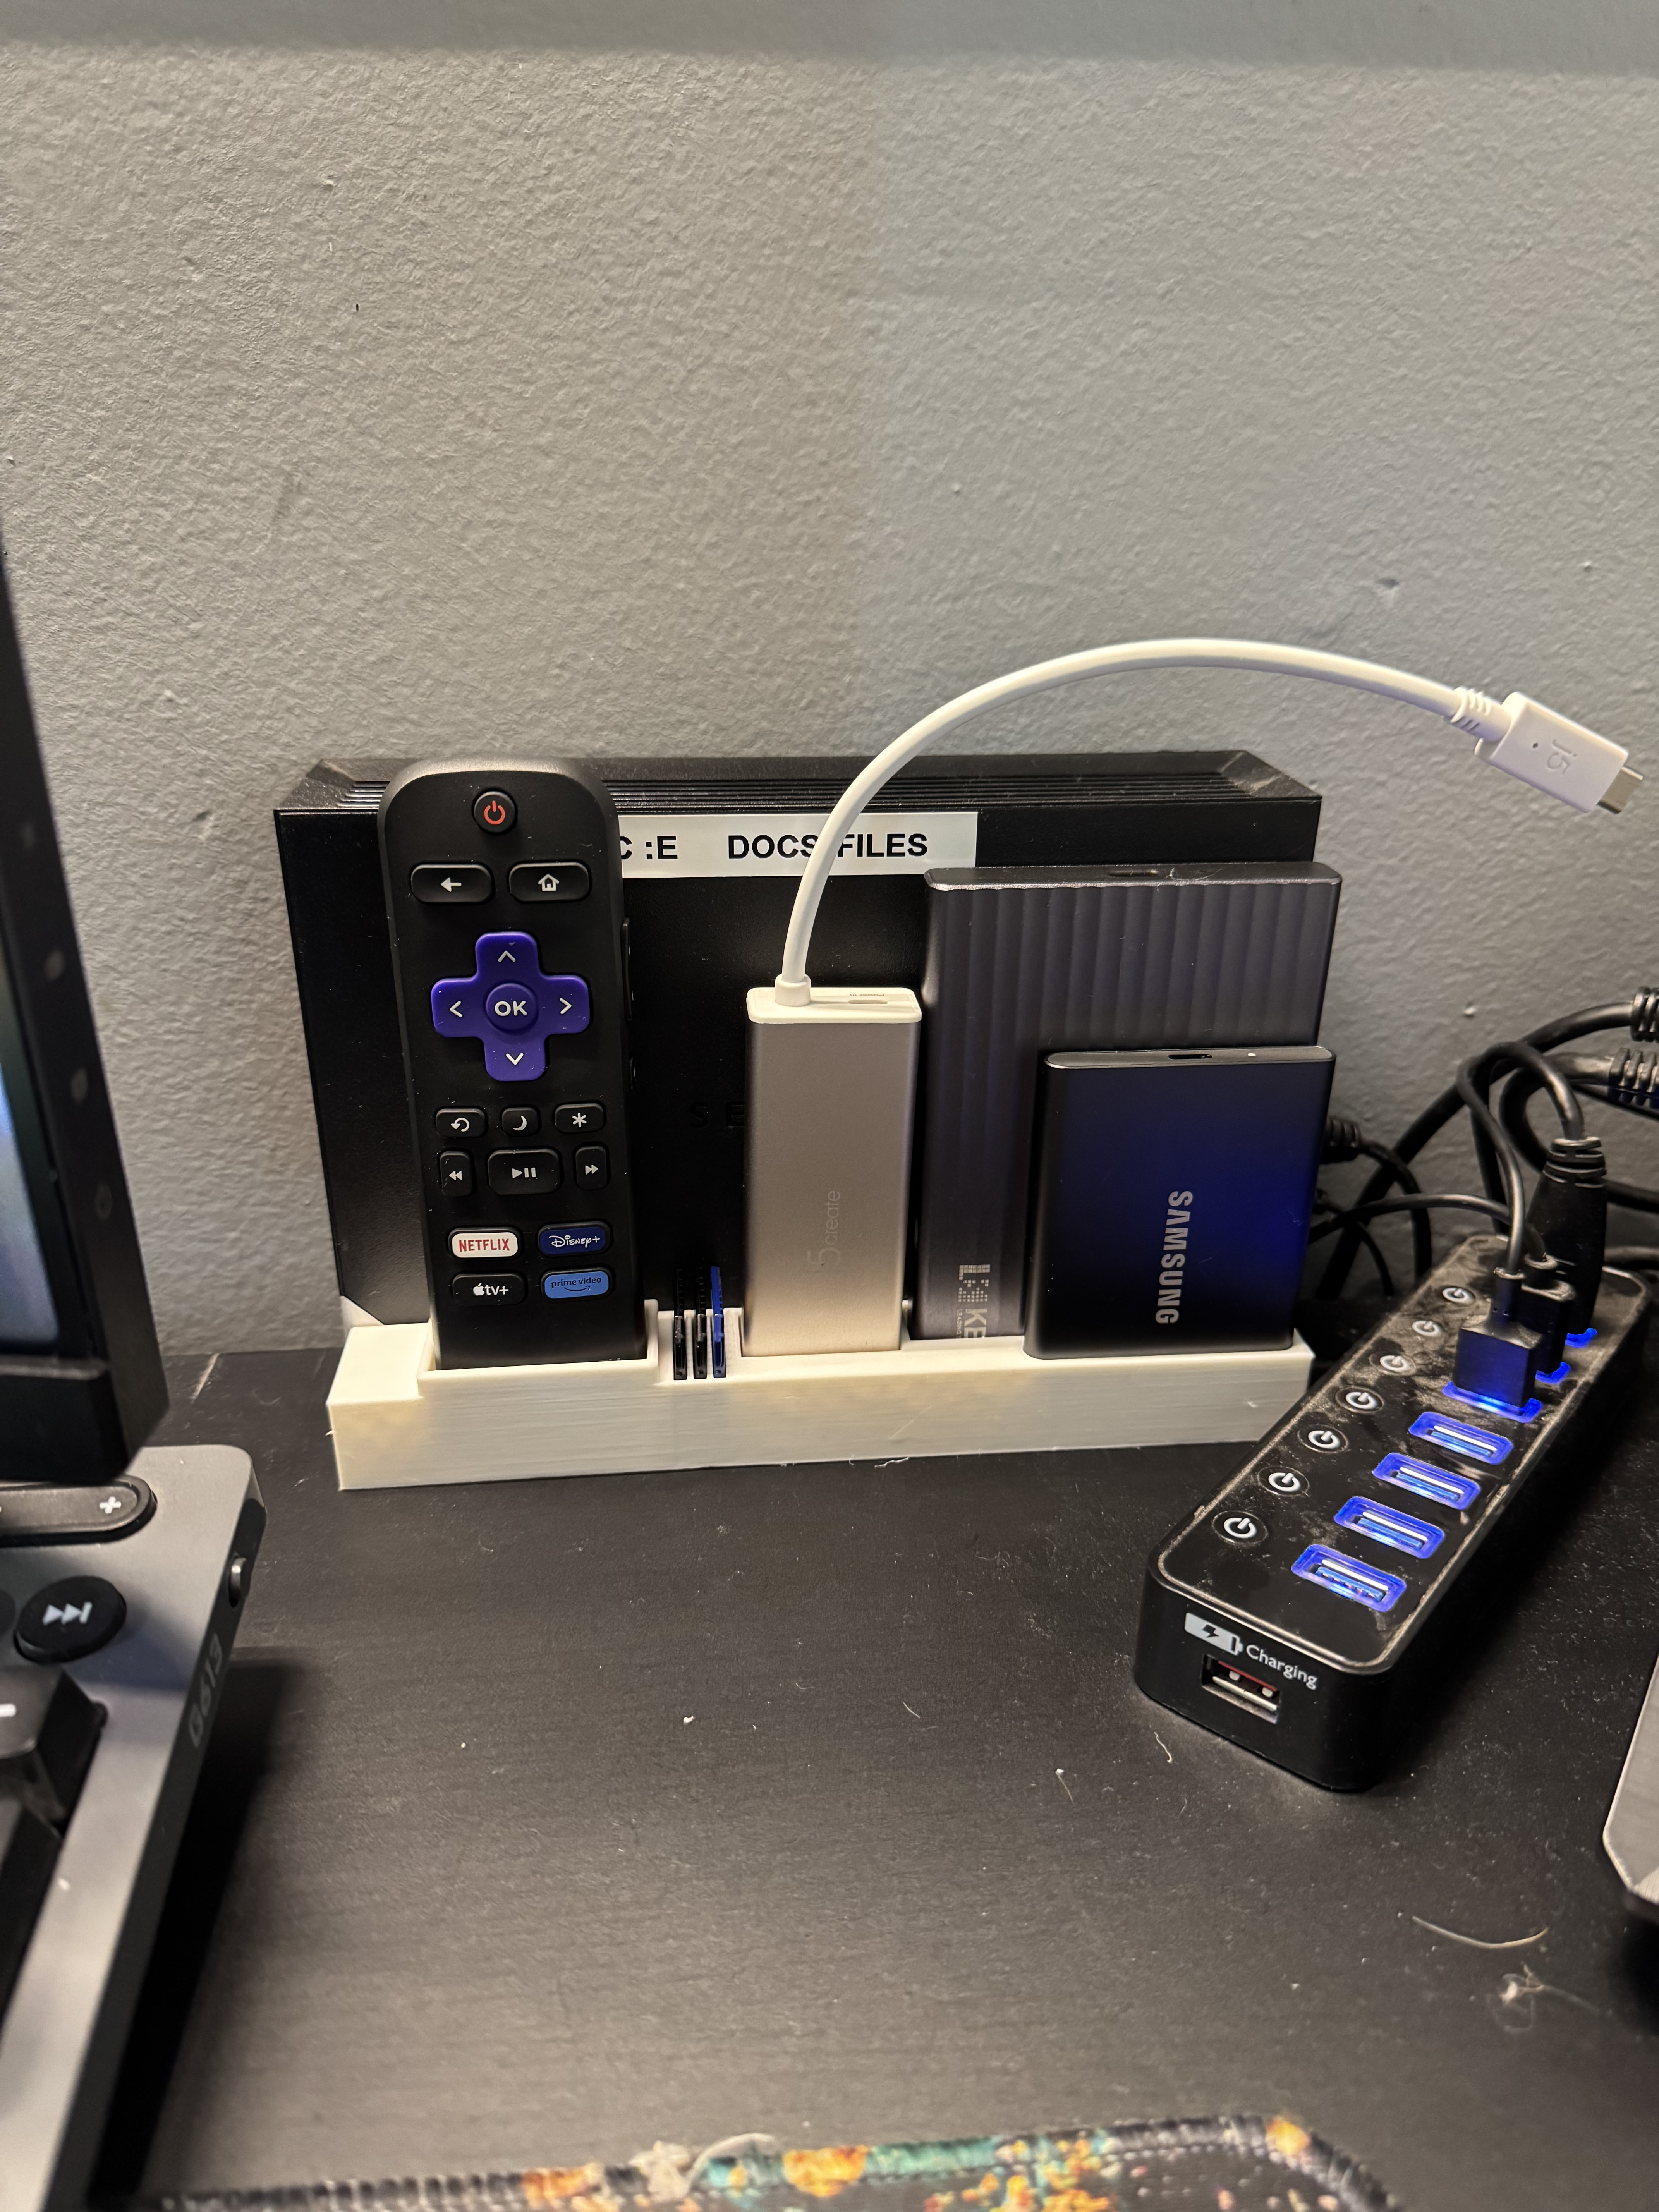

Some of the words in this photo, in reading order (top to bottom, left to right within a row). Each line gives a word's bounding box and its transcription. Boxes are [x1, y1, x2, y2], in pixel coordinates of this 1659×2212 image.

[728, 834, 819, 859] DOCS
[837, 833, 928, 858] FILES
[495, 1000, 527, 1017] OK
[459, 1238, 510, 1252] NETFLIX
[548, 1234, 600, 1248] Disney+
[1155, 1190, 1193, 1324] SAMSUNG
[551, 1278, 577, 1288] prime
[579, 1276, 601, 1285] video
[485, 1284, 509, 1296] tv+
[1246, 1644, 1317, 1690] Charging
